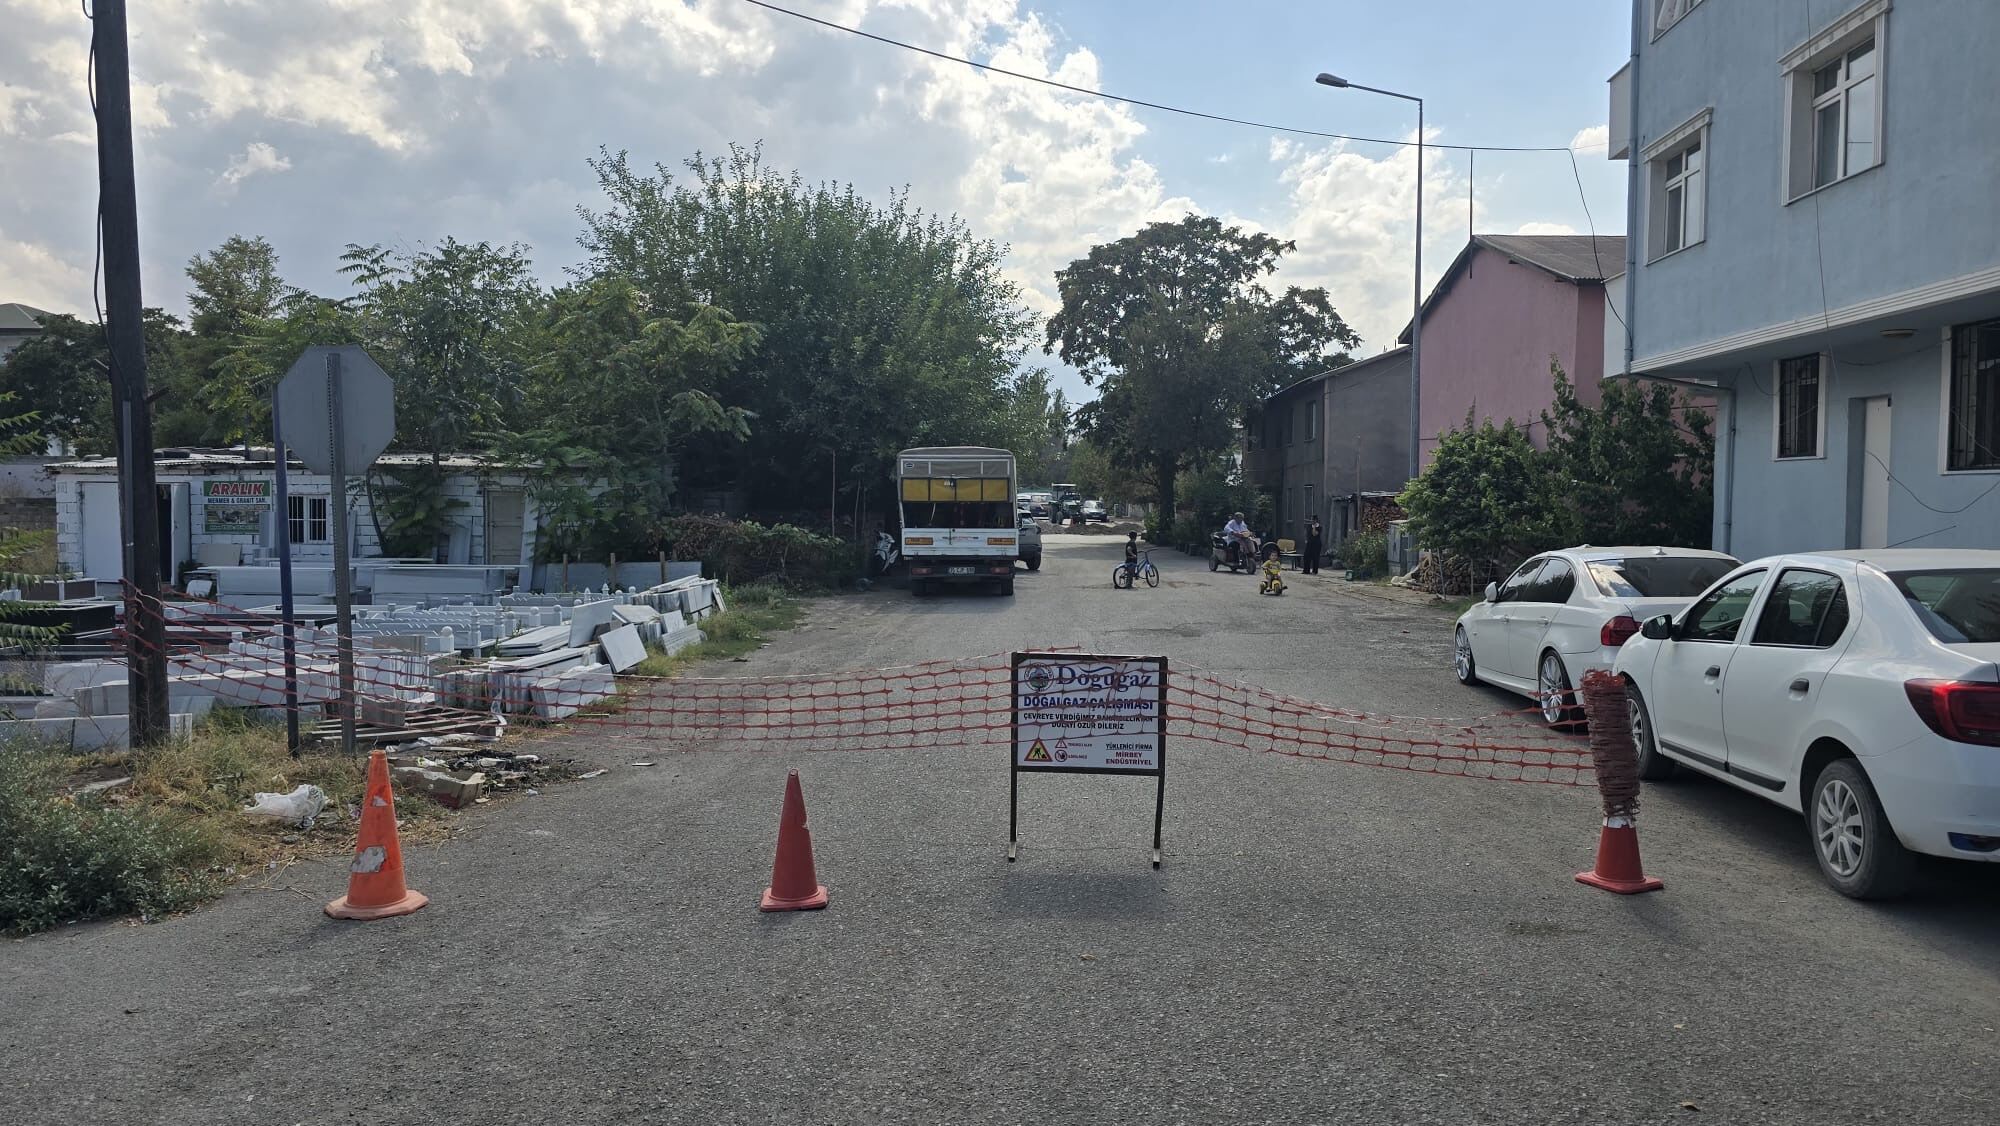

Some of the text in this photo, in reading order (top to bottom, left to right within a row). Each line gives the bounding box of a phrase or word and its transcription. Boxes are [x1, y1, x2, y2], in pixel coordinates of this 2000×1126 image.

[210, 483, 265, 496] ARALIK
[1024, 713, 1054, 721] ÇEVREYE
[1097, 722, 1125, 730] DİLERİZ
